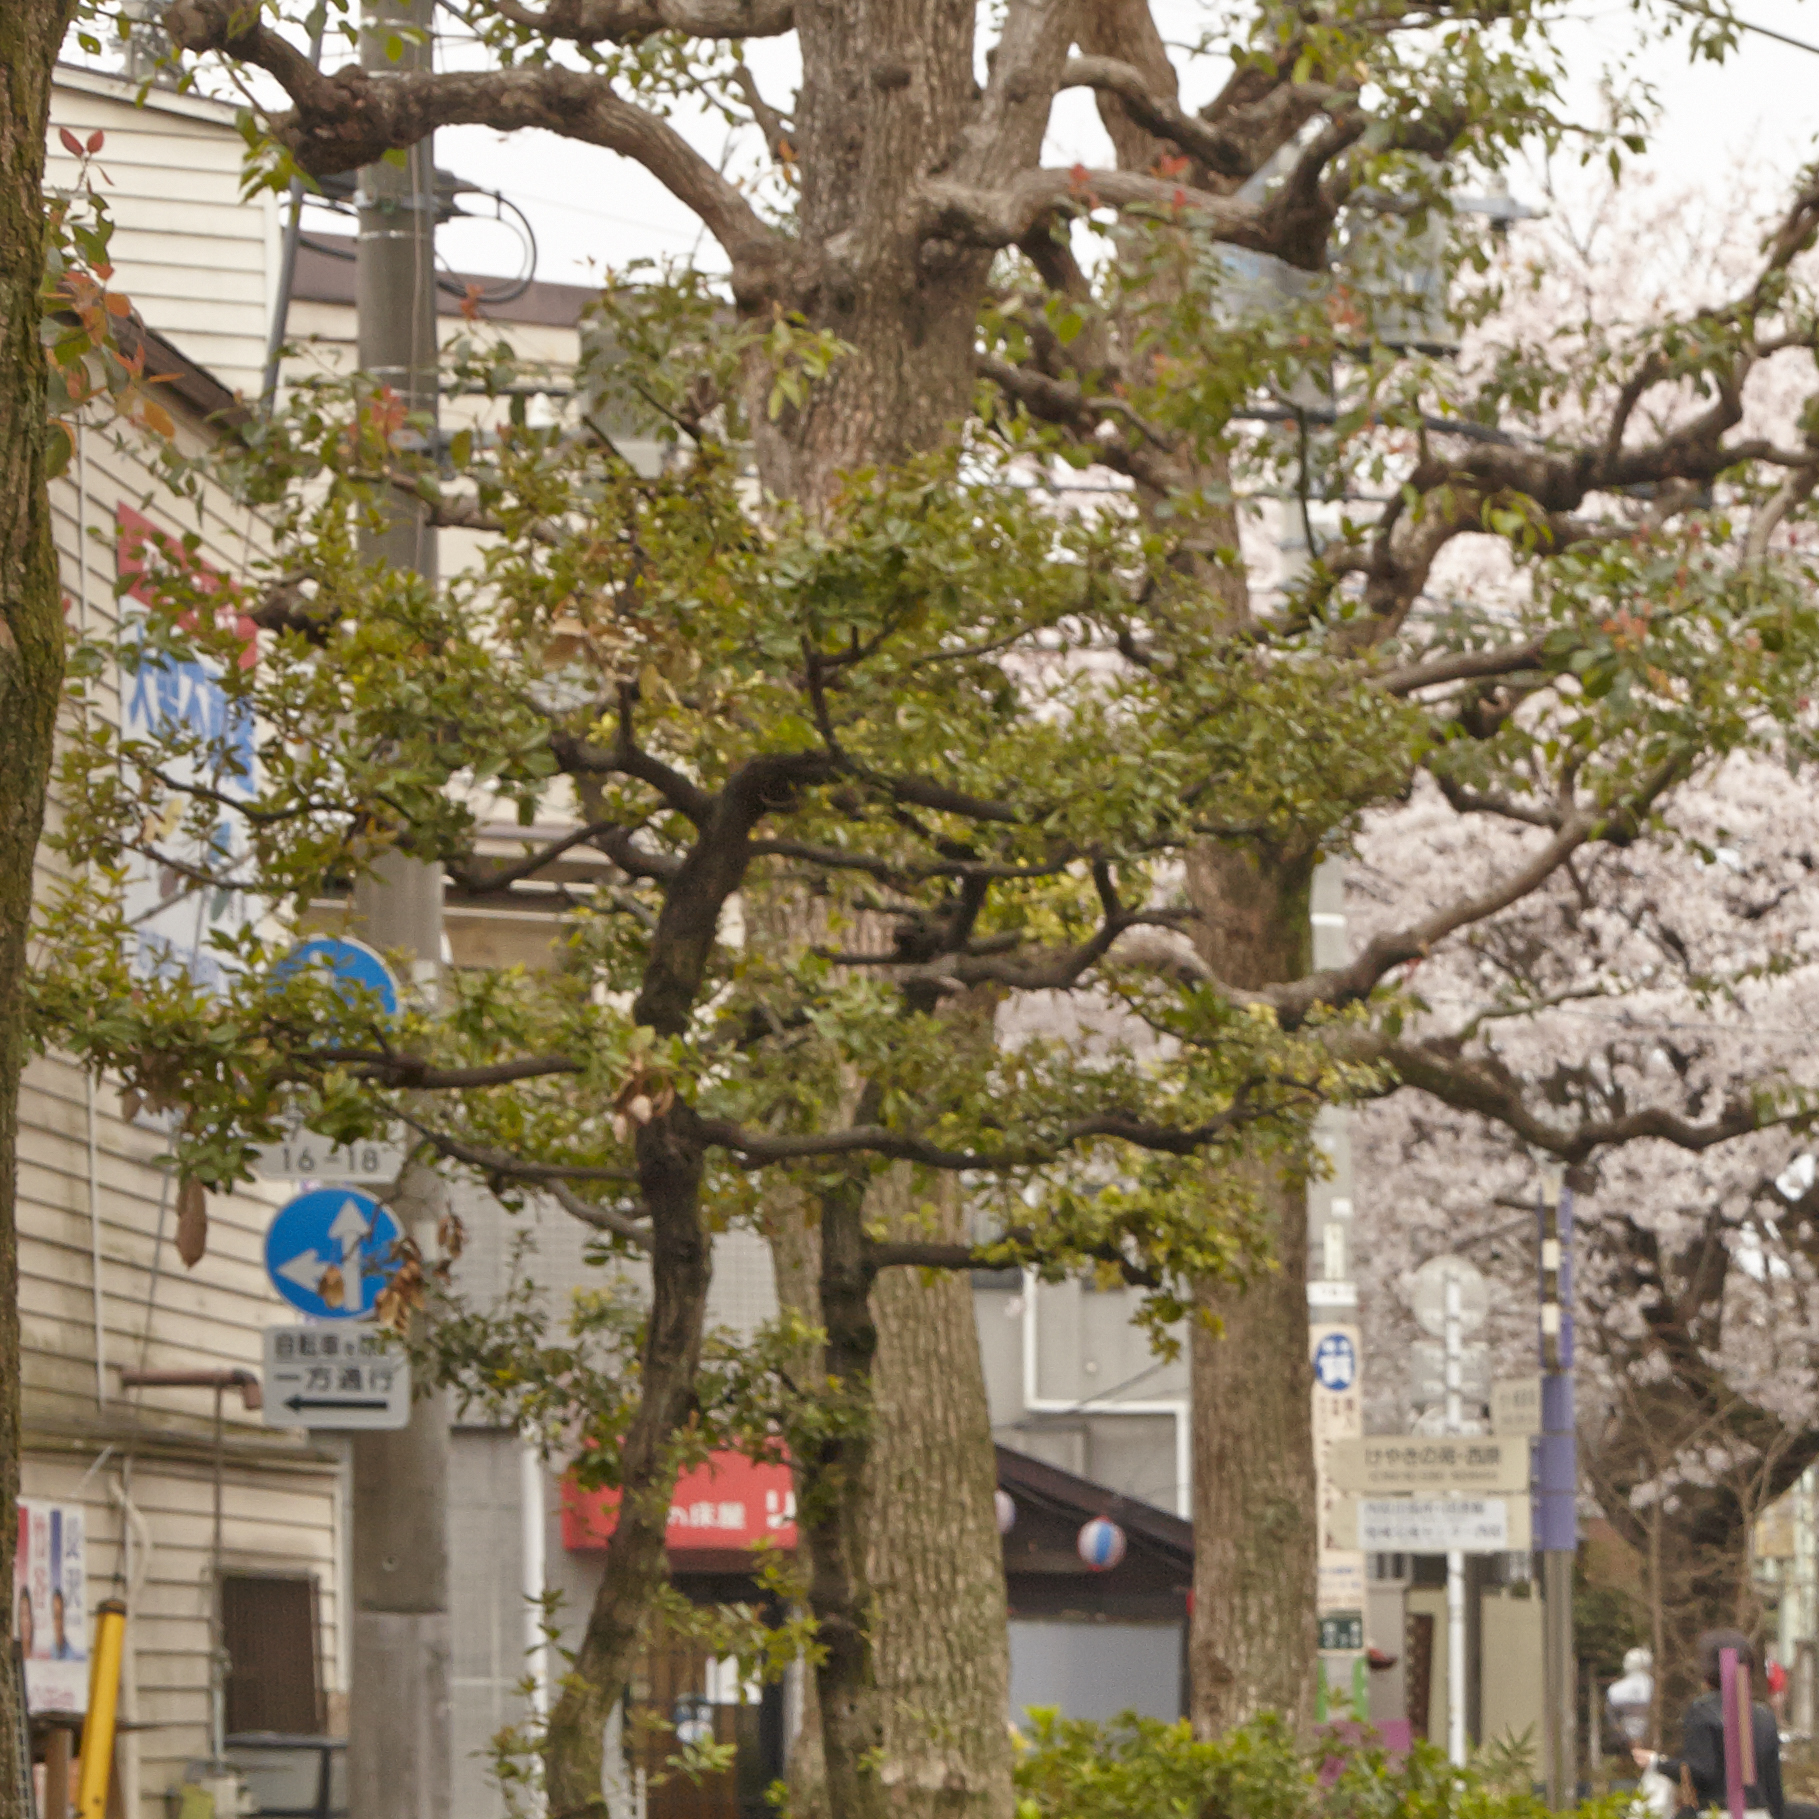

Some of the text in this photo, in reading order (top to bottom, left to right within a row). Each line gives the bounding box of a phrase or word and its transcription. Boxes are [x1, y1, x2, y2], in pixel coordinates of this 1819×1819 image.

[283, 1146, 379, 1173] 16-18
[274, 1366, 393, 1392] 一方通行
